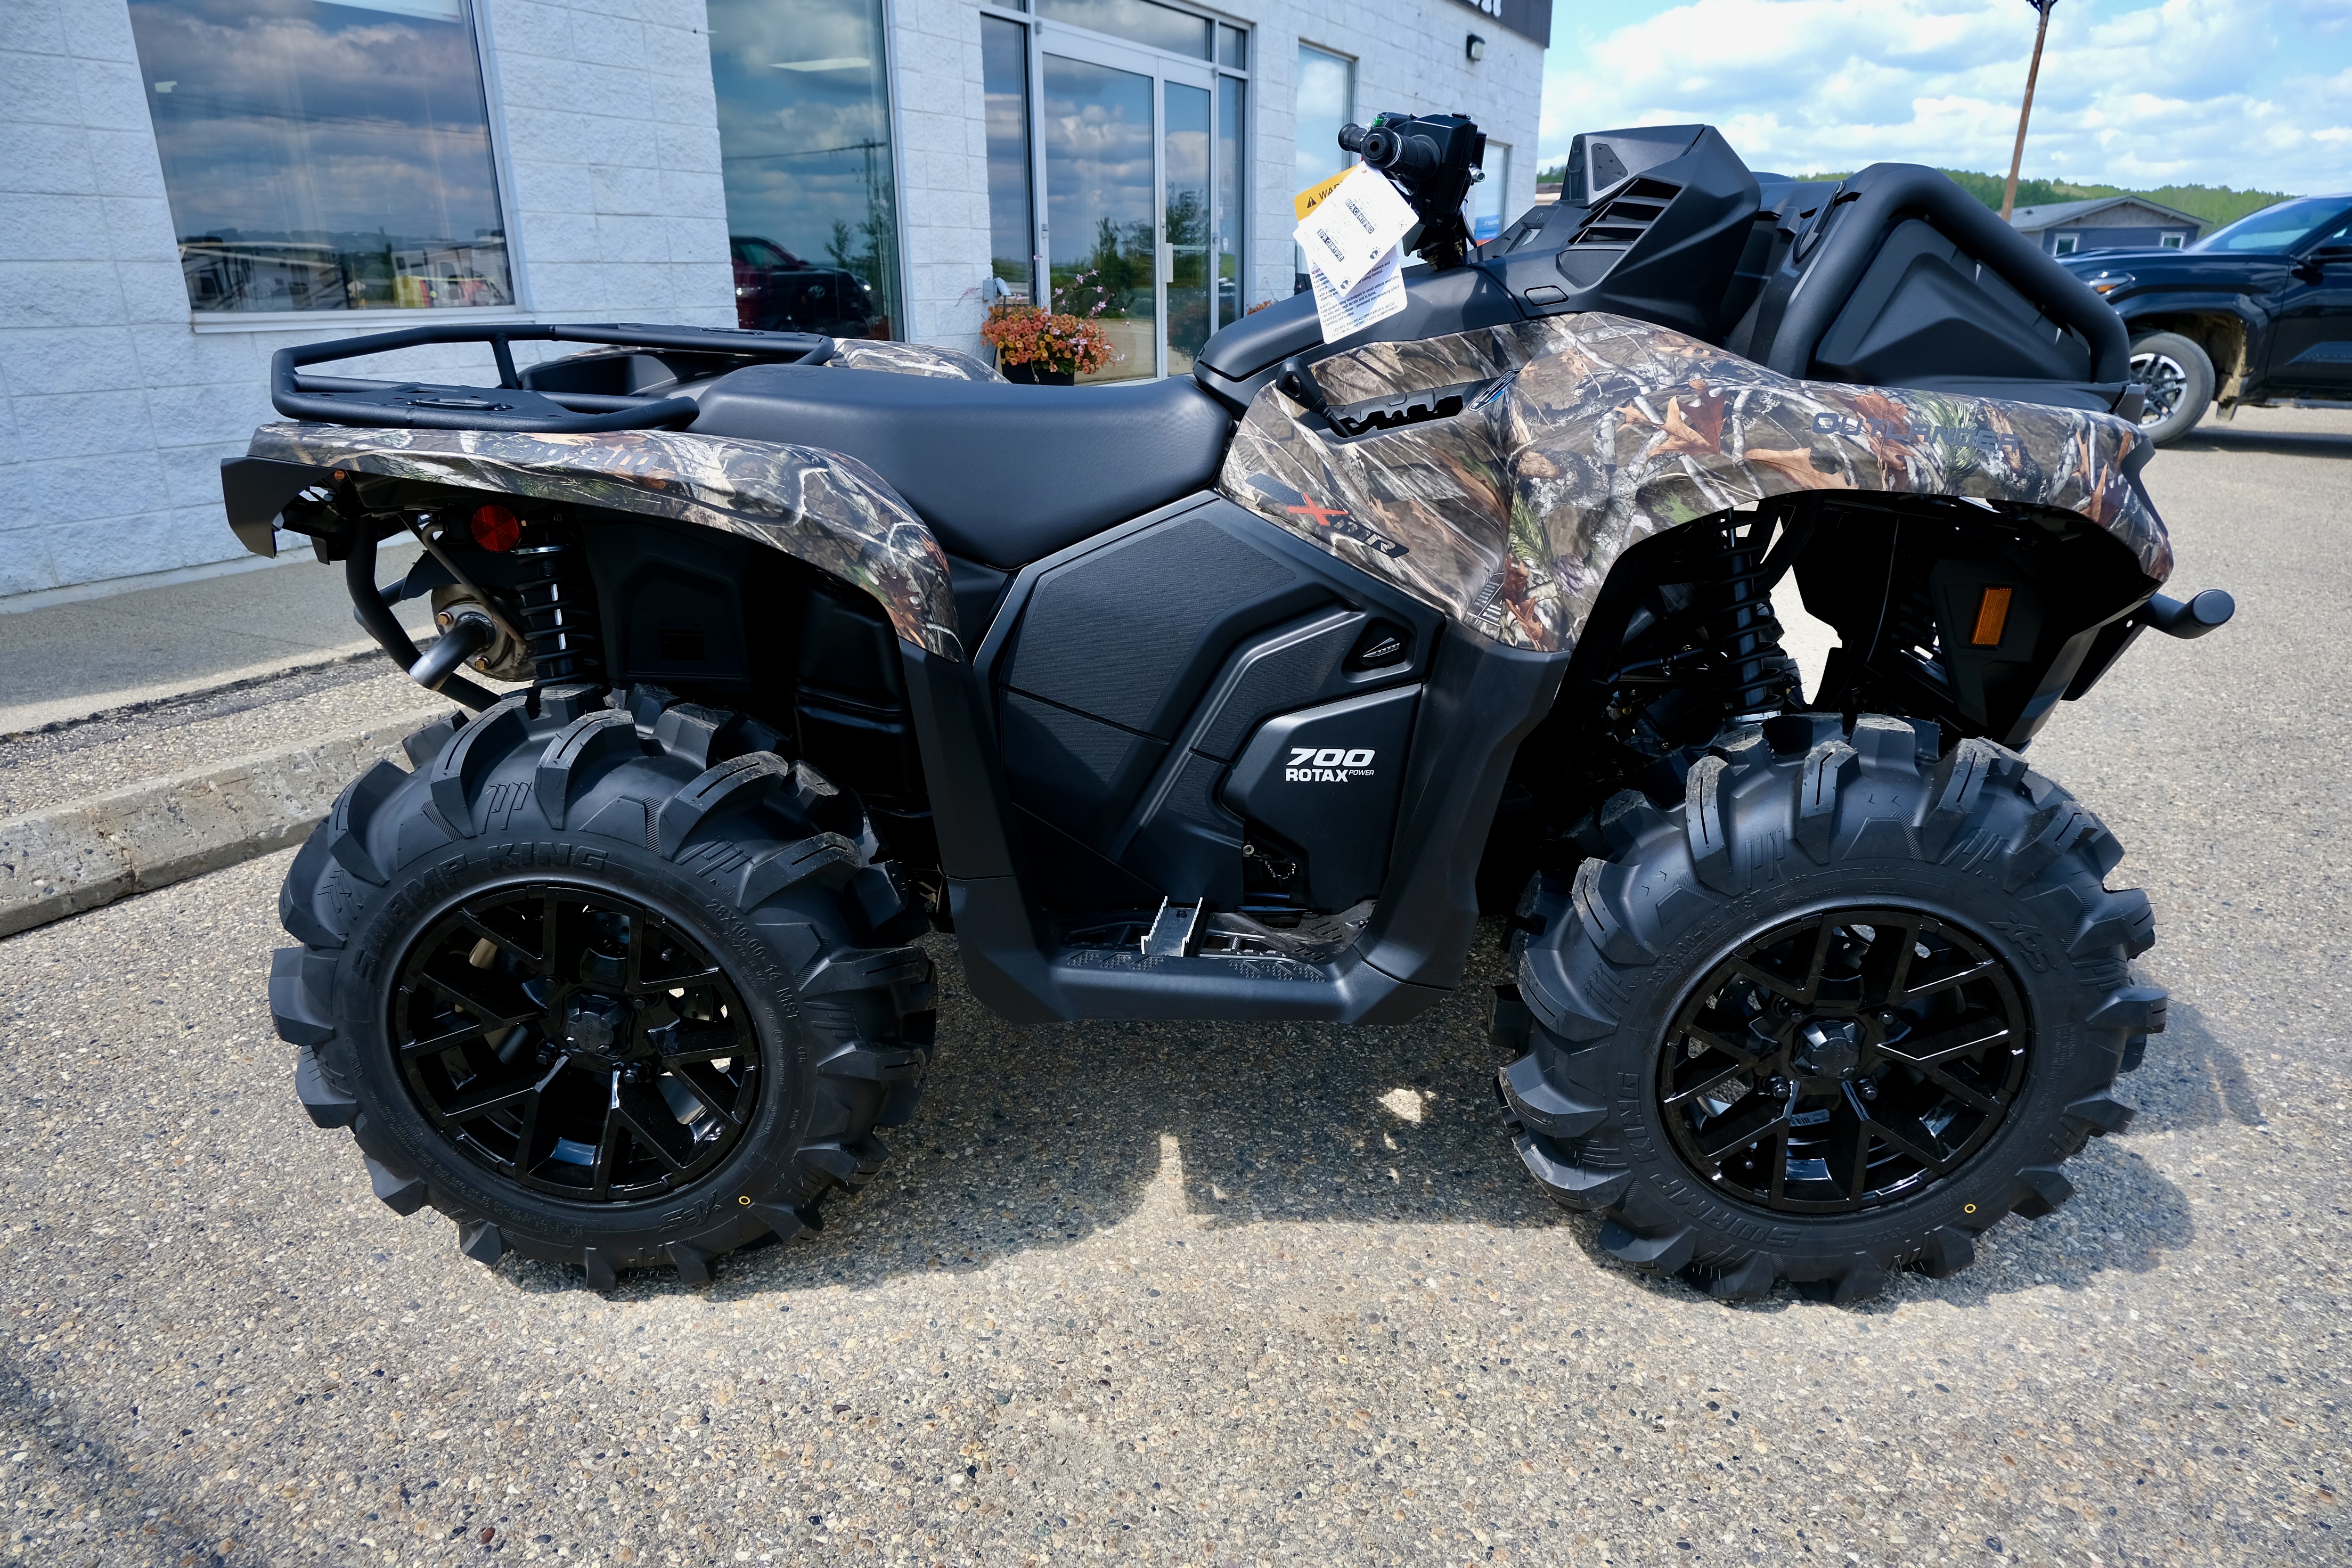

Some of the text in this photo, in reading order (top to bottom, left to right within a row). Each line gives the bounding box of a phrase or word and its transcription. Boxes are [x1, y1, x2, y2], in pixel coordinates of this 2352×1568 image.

[1812, 412, 2019, 452] OUTLANDER
[1286, 748, 1375, 767] 700
[1286, 768, 1349, 782] ROTAX
[1788, 874, 1808, 887] 6PR
[352, 842, 609, 981] SWAMP KING
[1646, 914, 1724, 989] 28X8.00-14
[1725, 888, 1767, 918] MST
[1988, 911, 2059, 973] XPS
[776, 986, 801, 1022] MST
[764, 1105, 779, 1132] ROTATION
[788, 1108, 801, 1130] NYLON
[1615, 1072, 1659, 1163] KING
[1649, 1173, 1802, 1248] SWAMP
